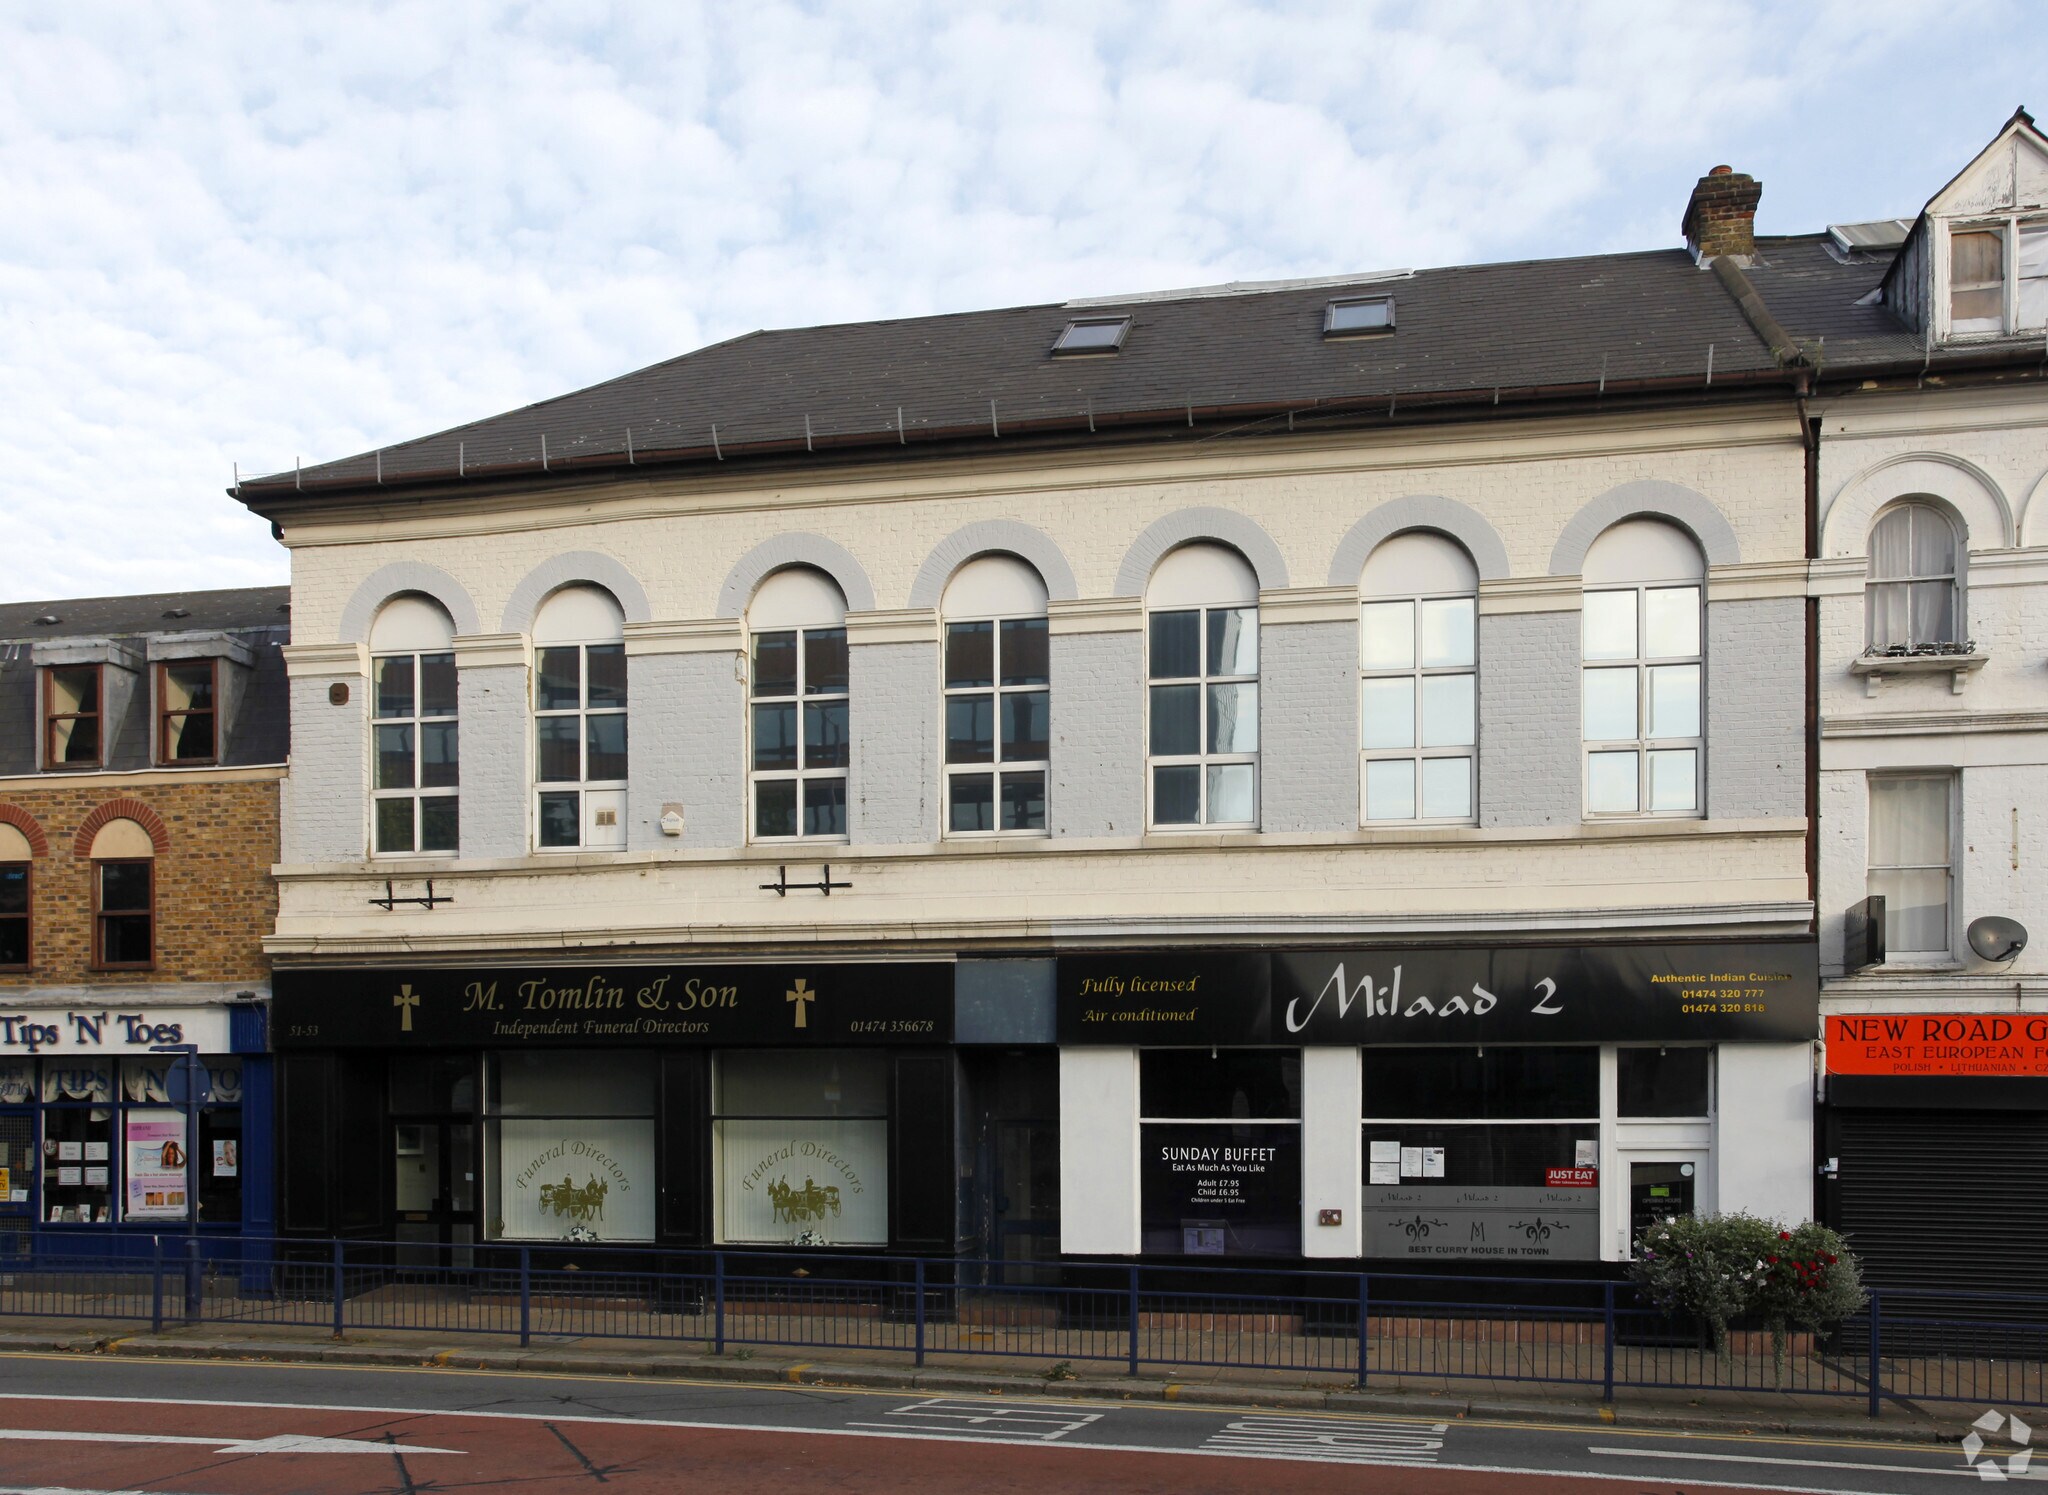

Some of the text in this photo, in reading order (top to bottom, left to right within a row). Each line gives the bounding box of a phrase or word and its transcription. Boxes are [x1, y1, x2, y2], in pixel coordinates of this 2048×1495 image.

[1651, 973, 1706, 983] Authentic
[1710, 973, 1745, 983] Indian
[463, 974, 738, 1011] M. Tomlin & Son
[1080, 975, 1200, 997] Fully licensed
[1286, 962, 1564, 1033] Milaad 2
[1682, 988, 1765, 999] 01474 320 777
[1082, 1007, 1199, 1022] Air conditioned
[1682, 1003, 1765, 1013] 01474 320 818
[0, 1015, 59, 1051] Tips
[117, 1014, 183, 1044] Toes
[493, 1019, 709, 1039] Independent Funeral Directors
[851, 1020, 934, 1033] 01474 356678
[1838, 1019, 1909, 1042] NEW
[1922, 1019, 2012, 1042] ROAD
[1865, 1046, 1915, 1059] EAST
[1923, 1046, 2024, 1059] EUROPEAN
[1893, 1063, 1931, 1073] POLISH
[1951, 1063, 2016, 1072] LITHUANIAN
[50, 1068, 108, 1092] TIPS
[1161, 1147, 1276, 1161] SUNDAY BUFFET
[516, 1139, 631, 1193] Funeral Directors
[742, 1139, 863, 1195] Funeral Directors
[1172, 1164, 1265, 1173] Eat As Much As You Like
[1548, 1170, 1594, 1180] JUST EAT
[1197, 1179, 1217, 1187] Adult
[1197, 1188, 1239, 1196] Child £6.95
[1408, 1245, 1549, 1256] BEST CURRY HOUSE IN TOWN
